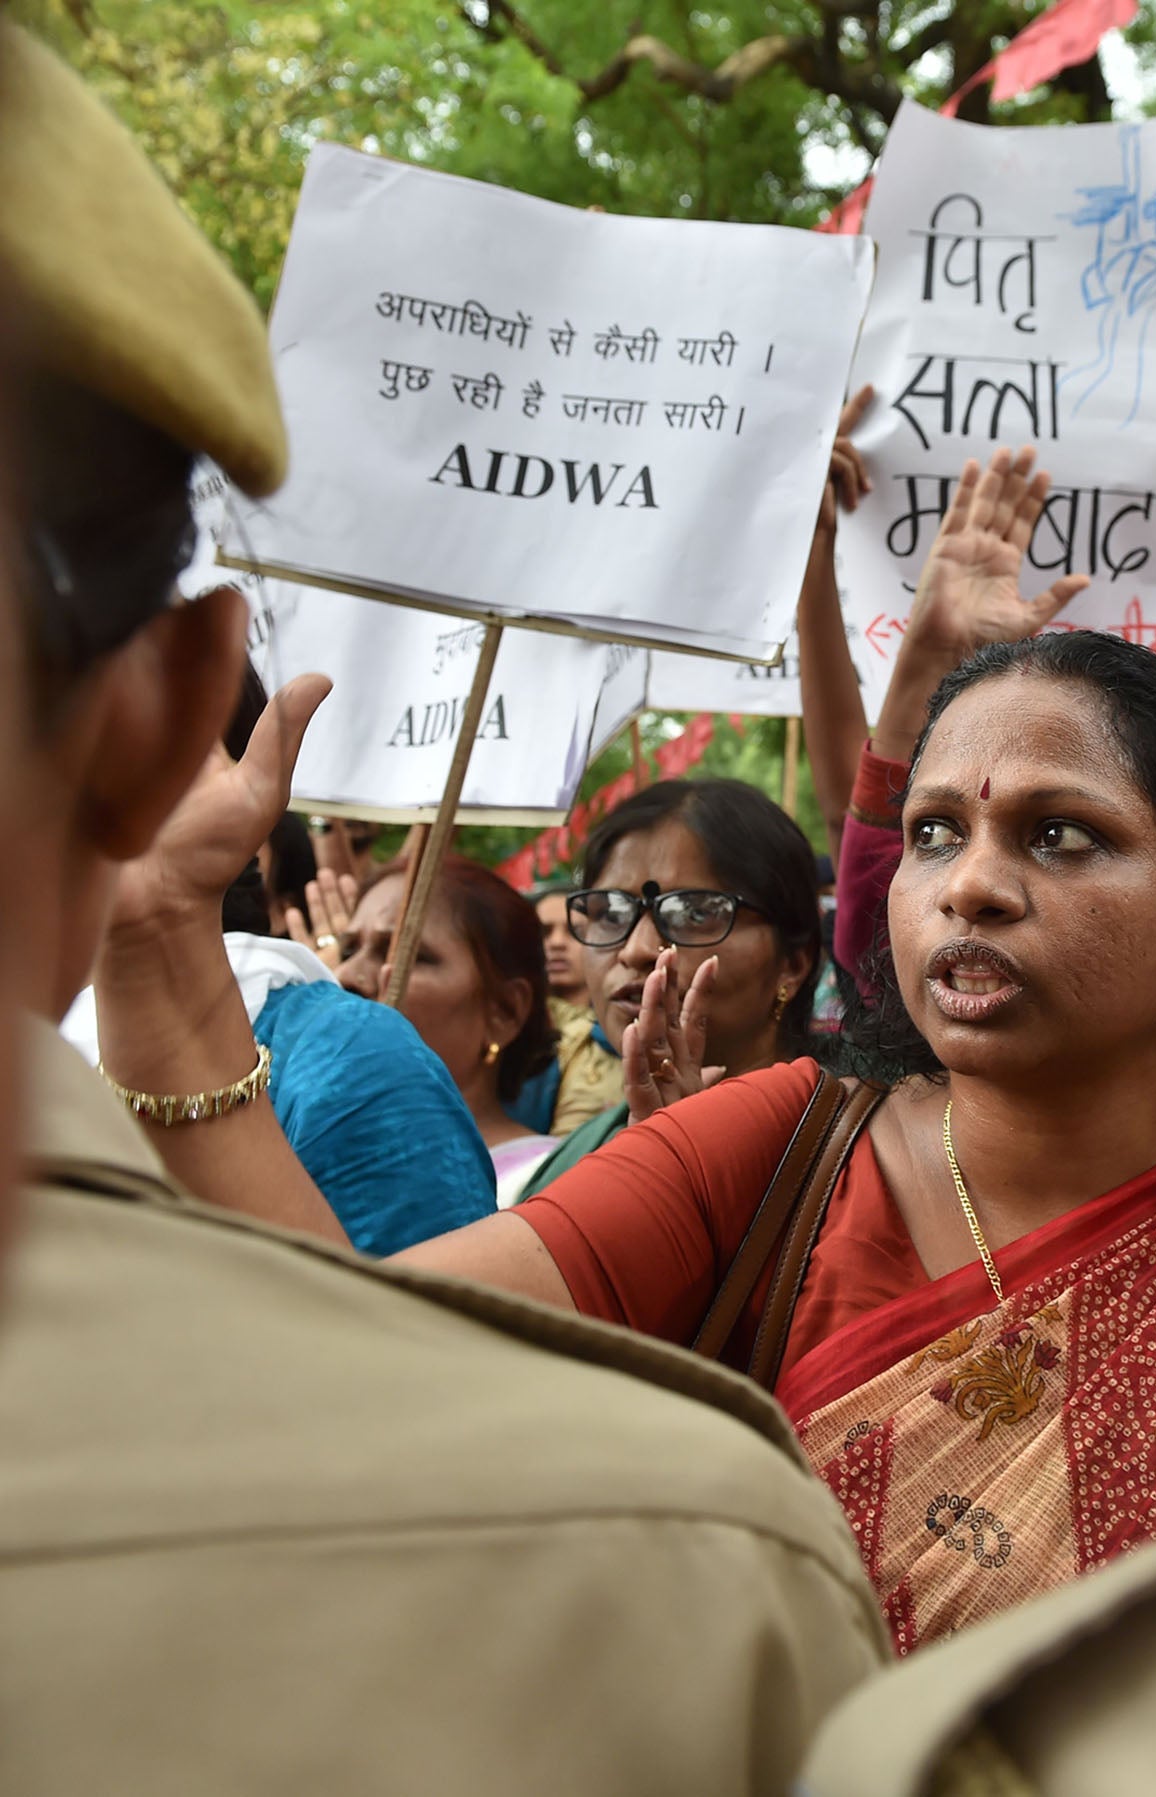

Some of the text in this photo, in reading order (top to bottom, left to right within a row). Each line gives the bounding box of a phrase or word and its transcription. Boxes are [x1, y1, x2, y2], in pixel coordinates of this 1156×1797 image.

[375, 292, 532, 350] अपराधियों
[548, 319, 576, 357] से
[593, 323, 661, 364] कैसी
[677, 330, 739, 367] यारी
[450, 371, 506, 411] रही
[521, 379, 546, 419] है
[561, 394, 649, 427] जनता
[891, 352, 1066, 452] सत्ता
[427, 442, 660, 509] AIDWA
